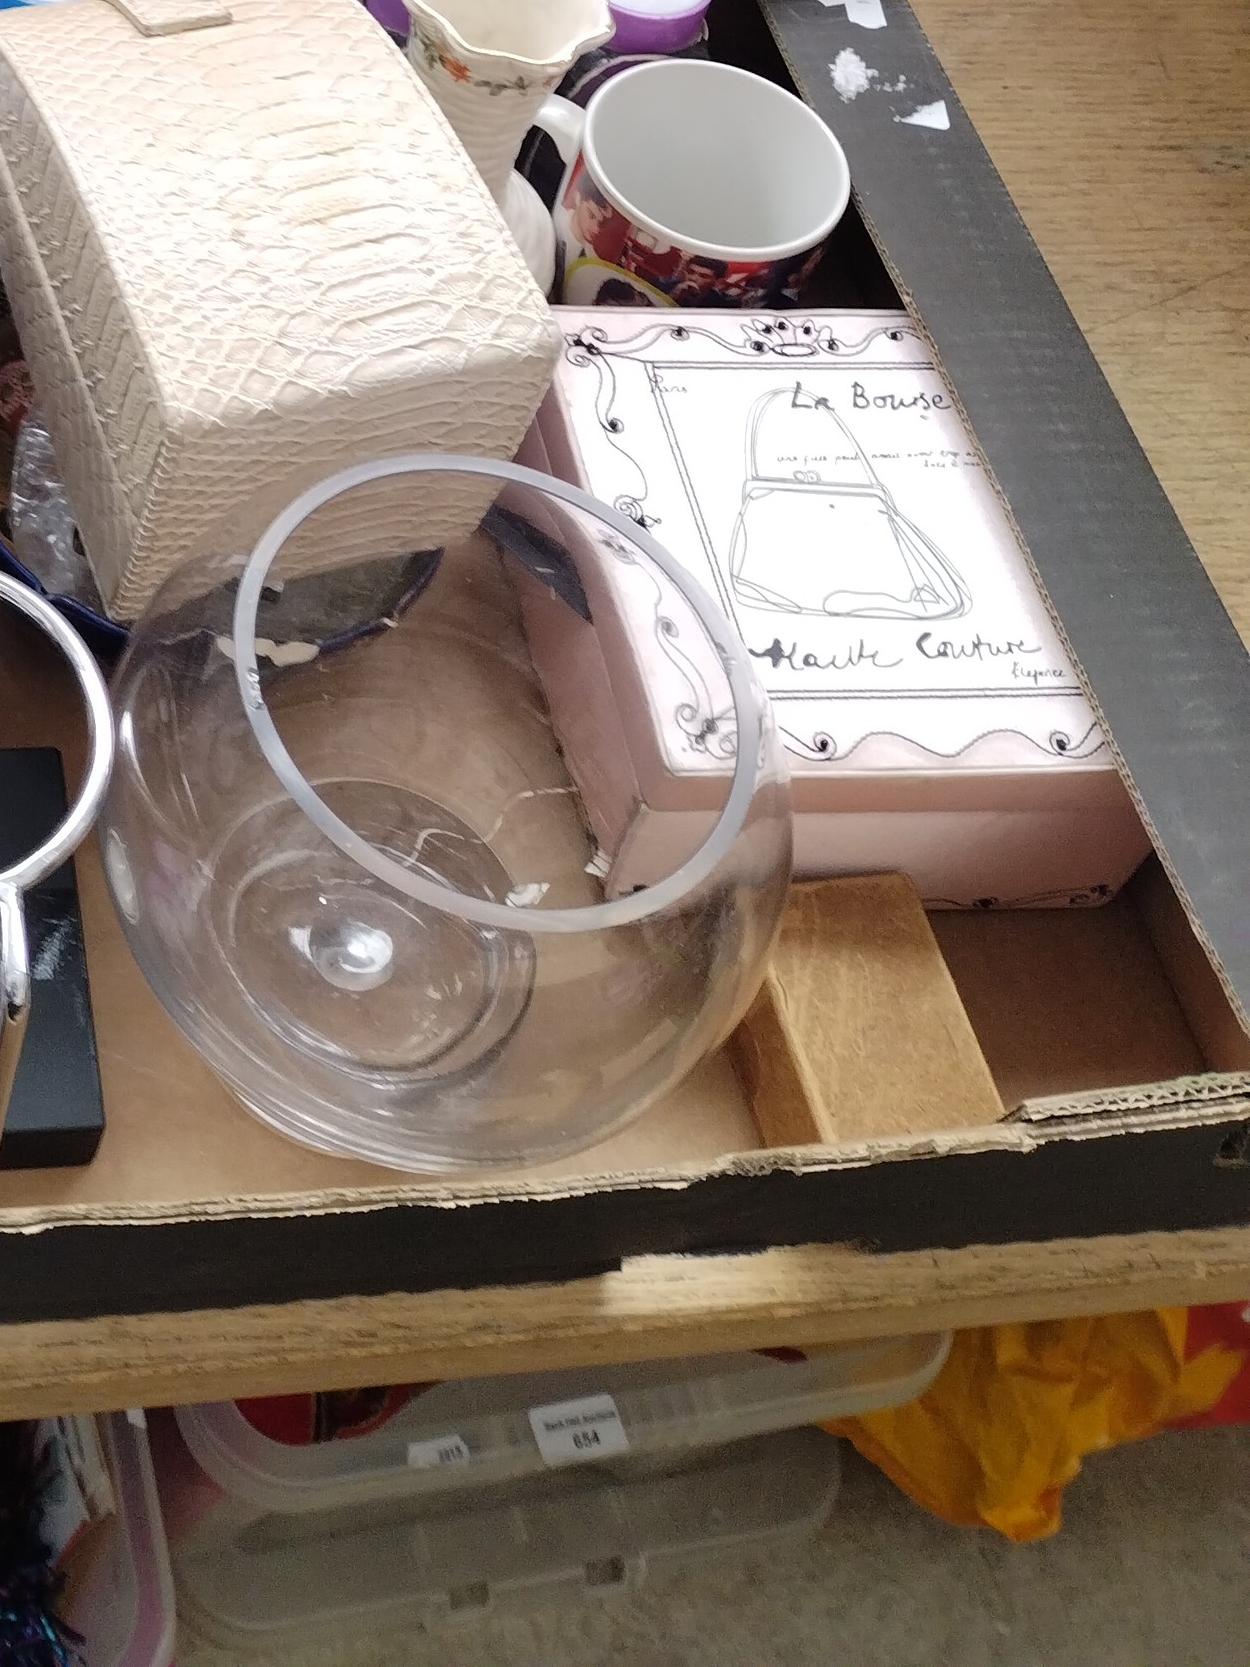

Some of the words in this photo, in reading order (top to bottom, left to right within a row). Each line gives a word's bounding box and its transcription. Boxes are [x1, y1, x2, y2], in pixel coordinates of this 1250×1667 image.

[791, 381, 835, 411] La
[916, 632, 1042, 661] Couture
[571, 1429, 601, 1450] 654
